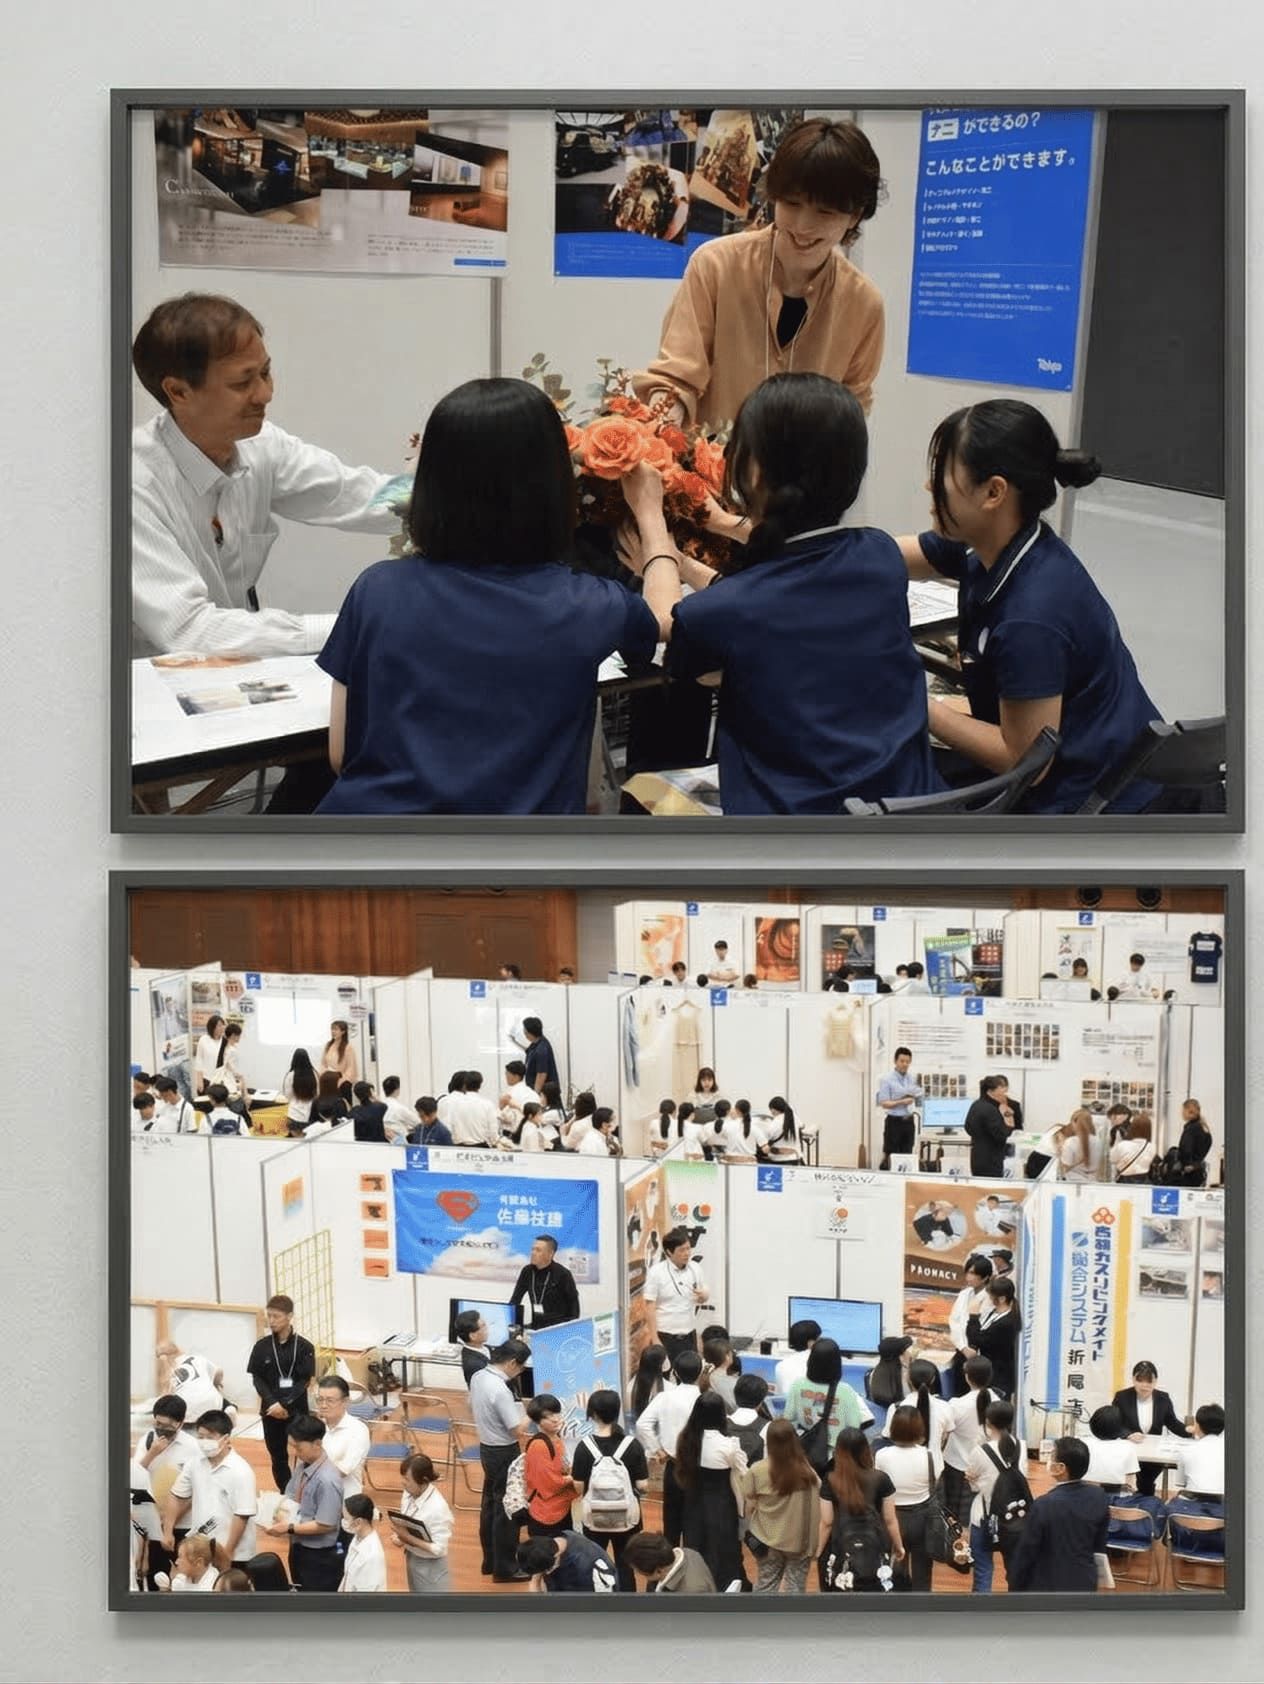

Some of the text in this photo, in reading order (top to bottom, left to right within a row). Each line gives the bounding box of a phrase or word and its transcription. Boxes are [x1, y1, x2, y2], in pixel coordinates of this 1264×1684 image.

[926, 148, 1076, 176] こんなことができます。
